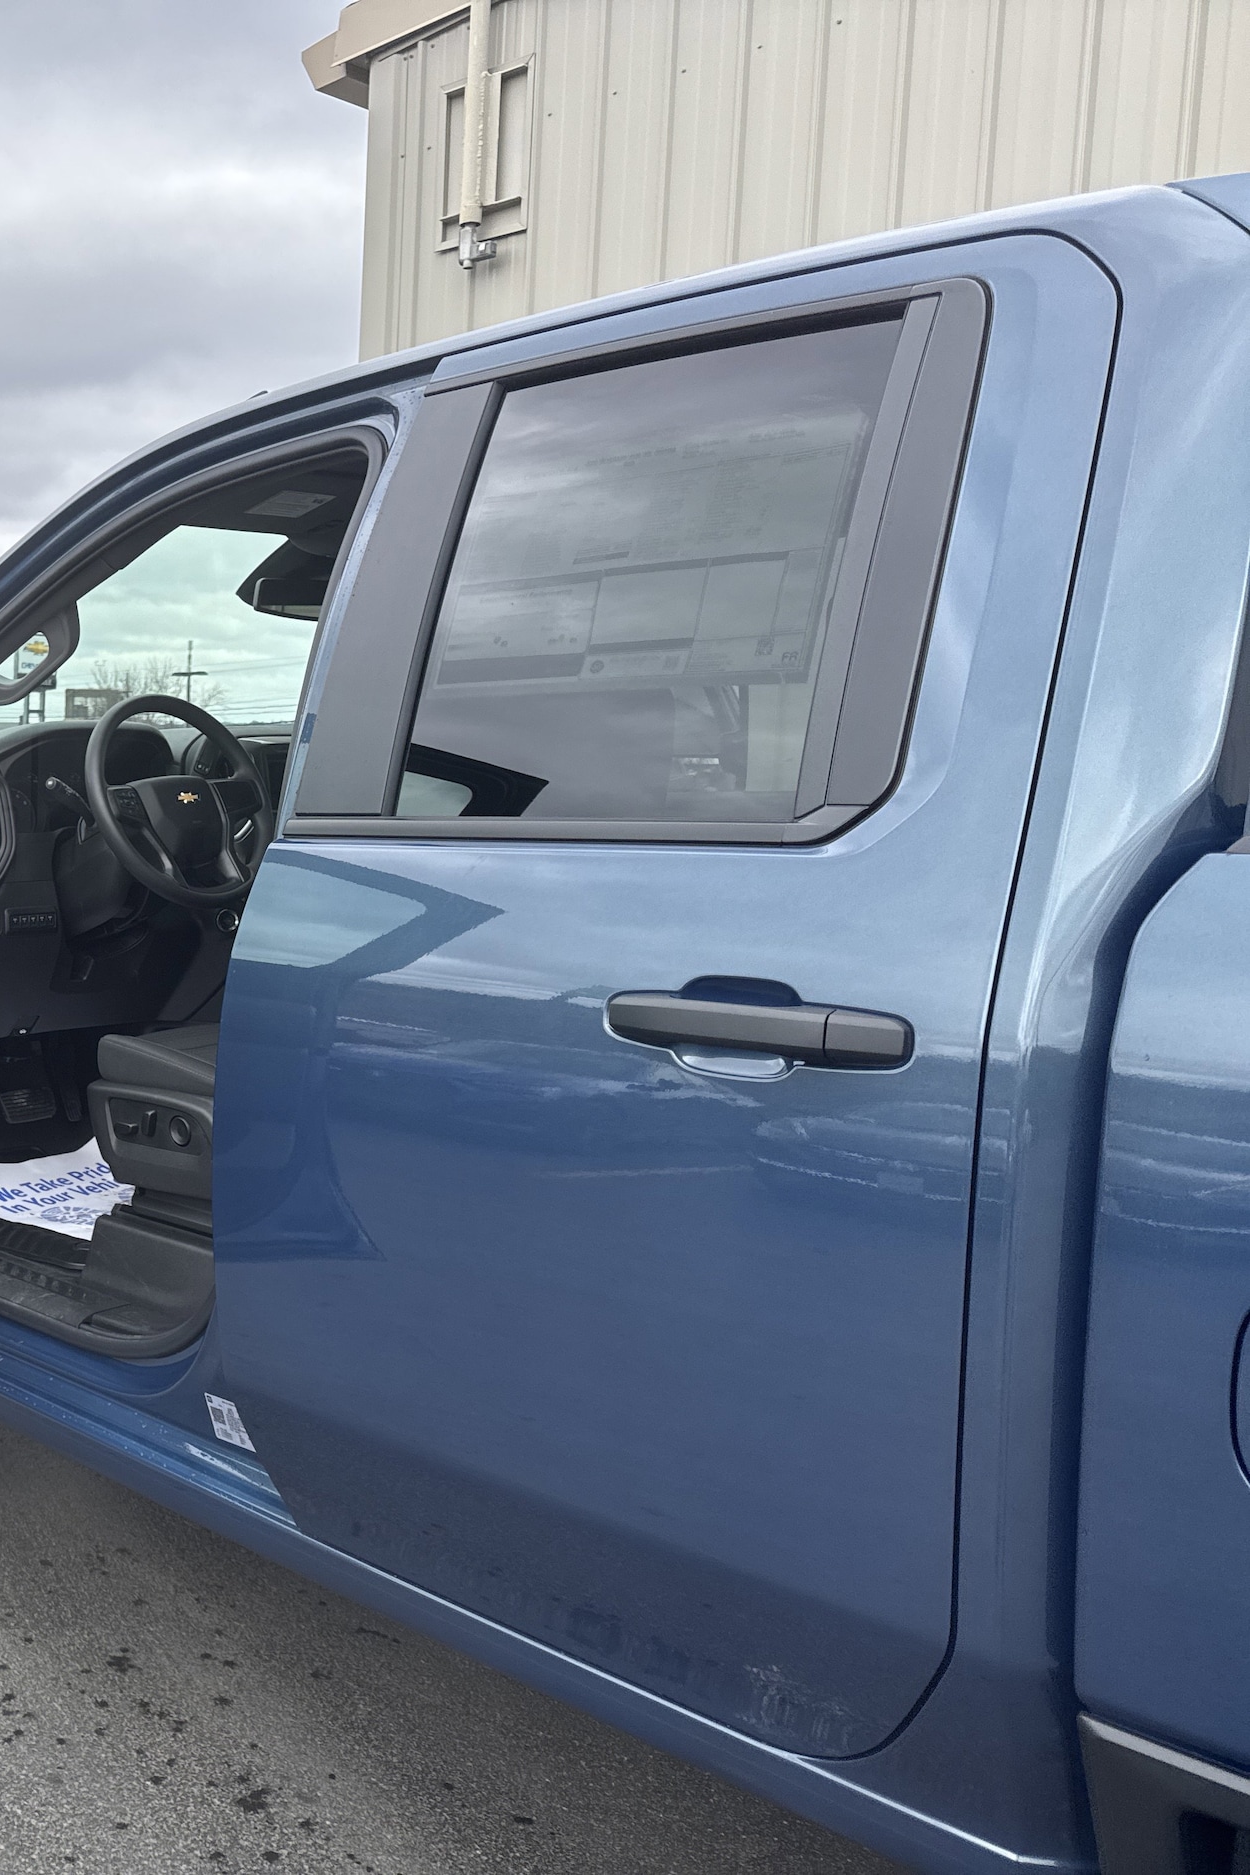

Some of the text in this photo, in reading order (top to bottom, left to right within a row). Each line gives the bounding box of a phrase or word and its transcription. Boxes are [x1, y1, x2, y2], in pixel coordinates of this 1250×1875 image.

[19, 1178, 73, 1194] Take
[67, 1162, 111, 1181] Prid
[0, 1179, 120, 1214] In Your Vehi
